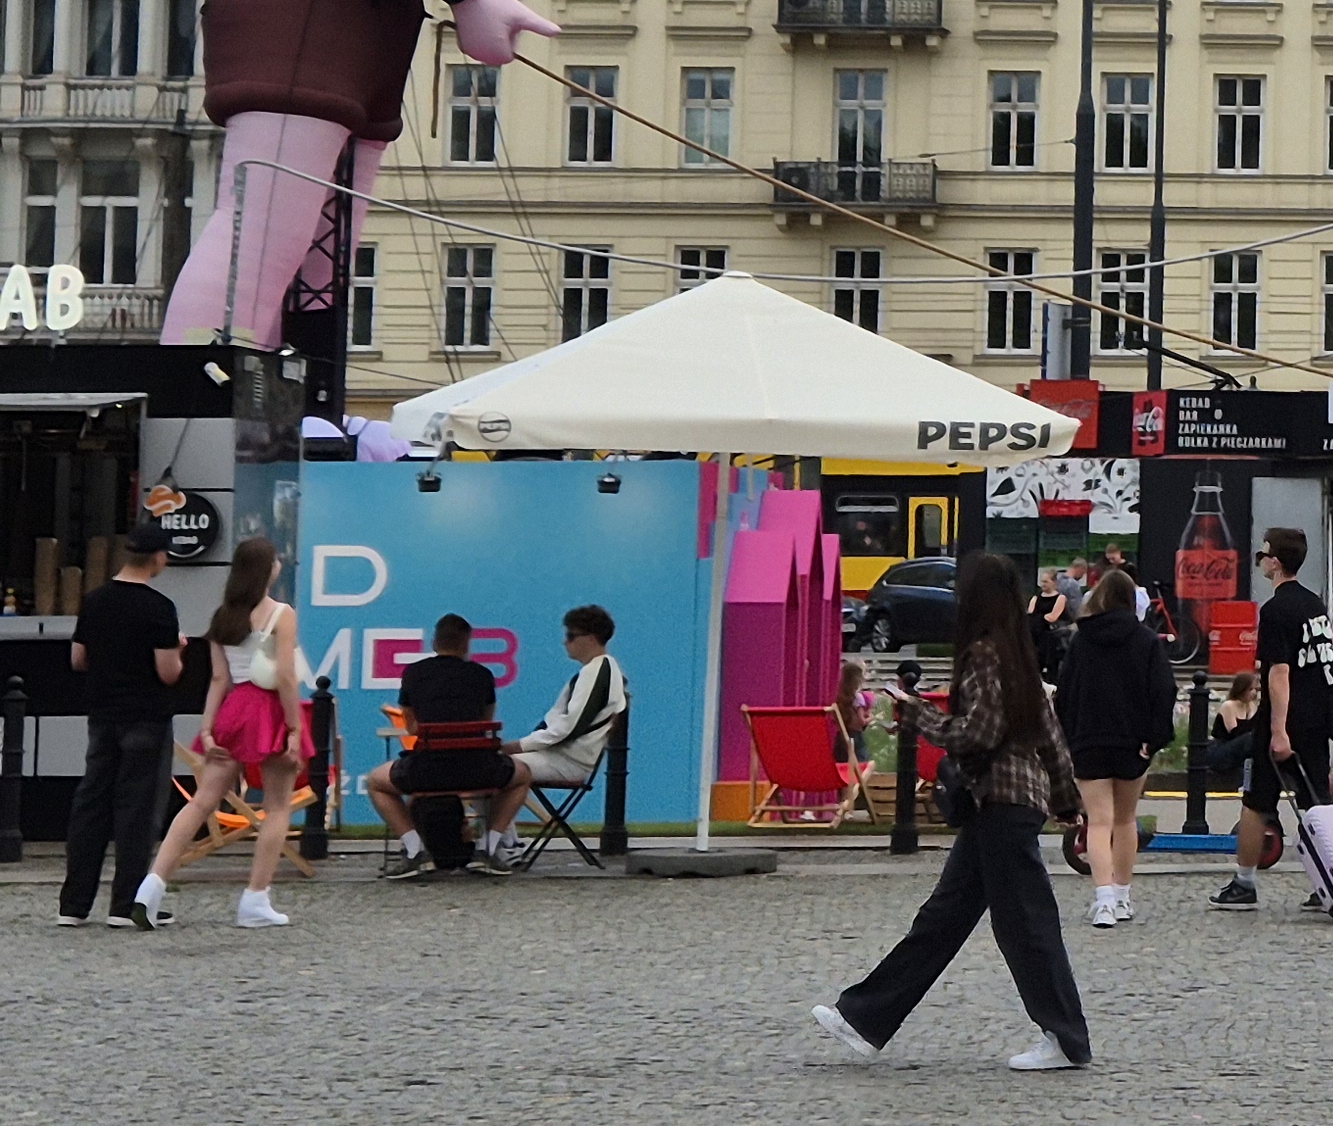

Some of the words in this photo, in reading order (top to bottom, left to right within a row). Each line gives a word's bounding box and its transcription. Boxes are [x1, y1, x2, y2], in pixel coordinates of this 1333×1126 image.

[916, 420, 1052, 451] PEPSI
[161, 513, 210, 530] HELLO
[310, 545, 388, 607] D
